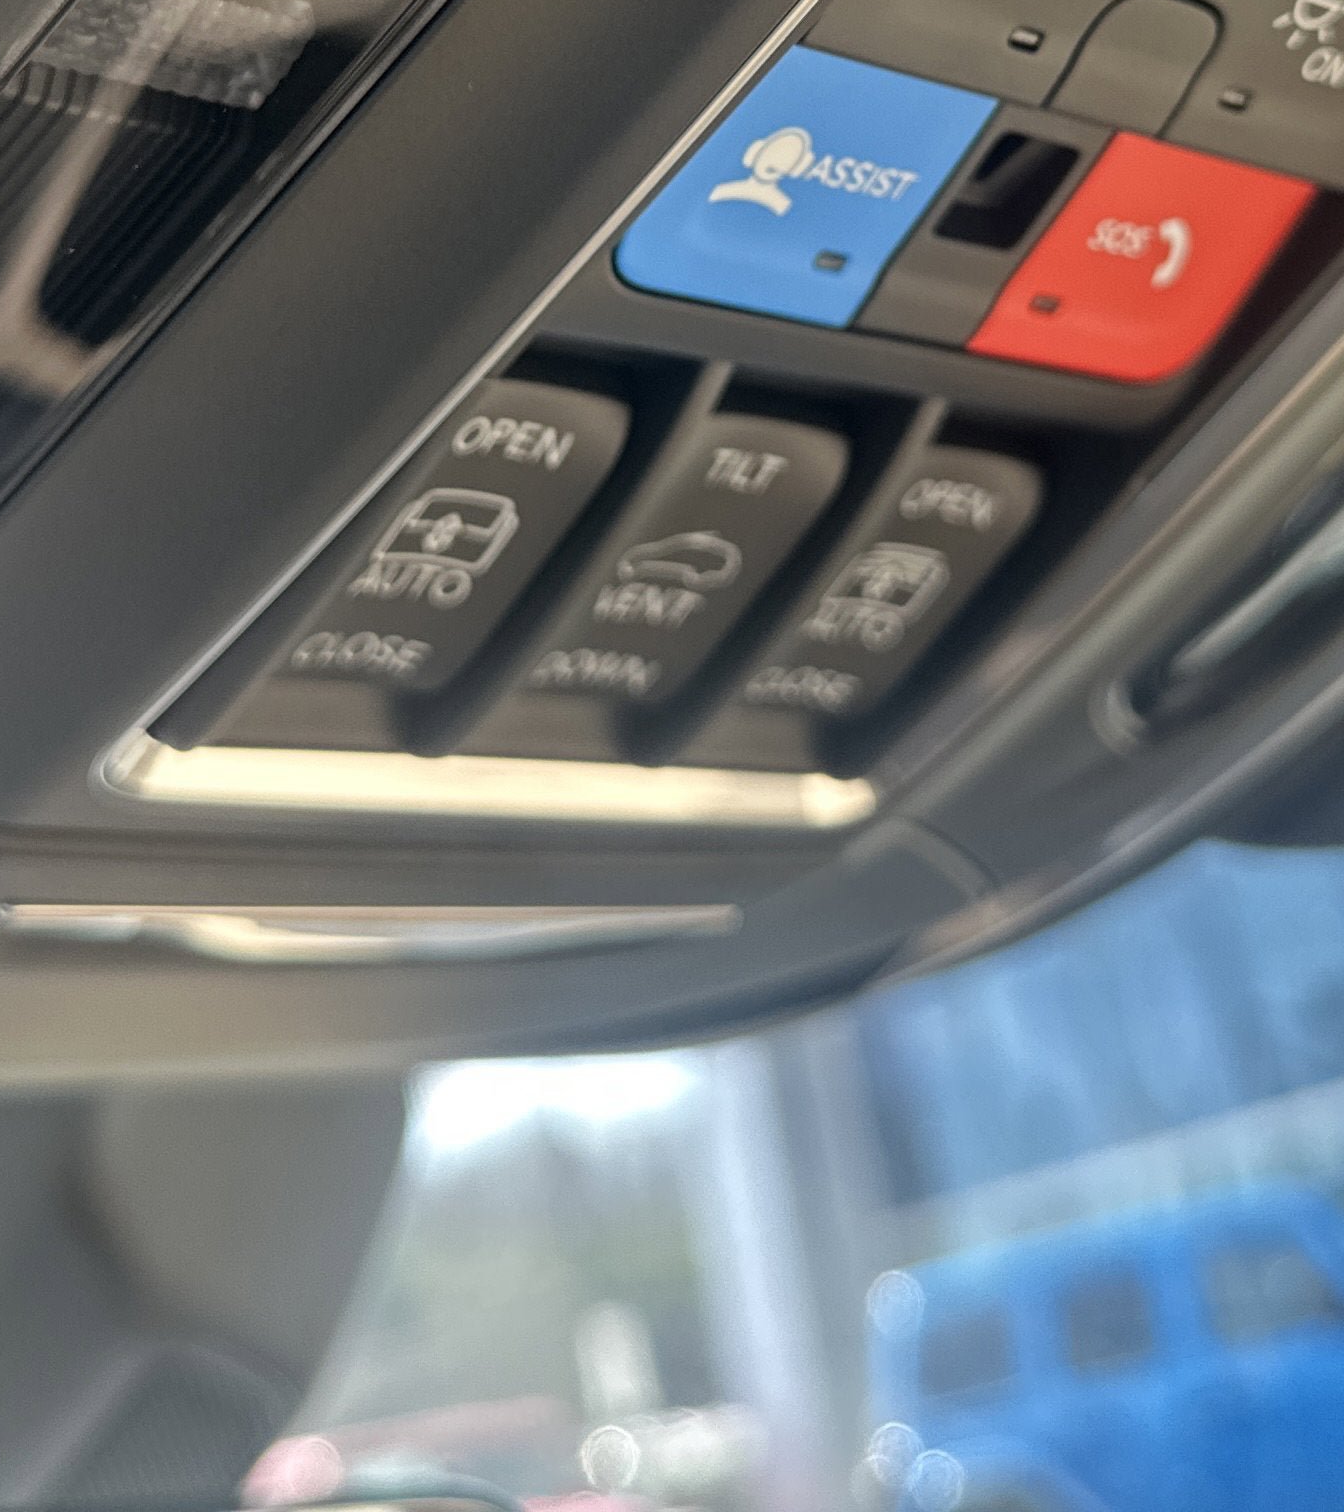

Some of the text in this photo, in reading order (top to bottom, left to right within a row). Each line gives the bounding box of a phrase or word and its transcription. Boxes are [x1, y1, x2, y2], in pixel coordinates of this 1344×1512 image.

[807, 154, 919, 200] ASSIST
[1086, 217, 1154, 260] SOS
[452, 415, 575, 470] OPEN
[707, 447, 789, 495] TILT
[899, 478, 994, 532] OPEN
[348, 559, 472, 609] AUTO
[593, 583, 705, 627] VENT
[290, 631, 434, 678] CLOSE
